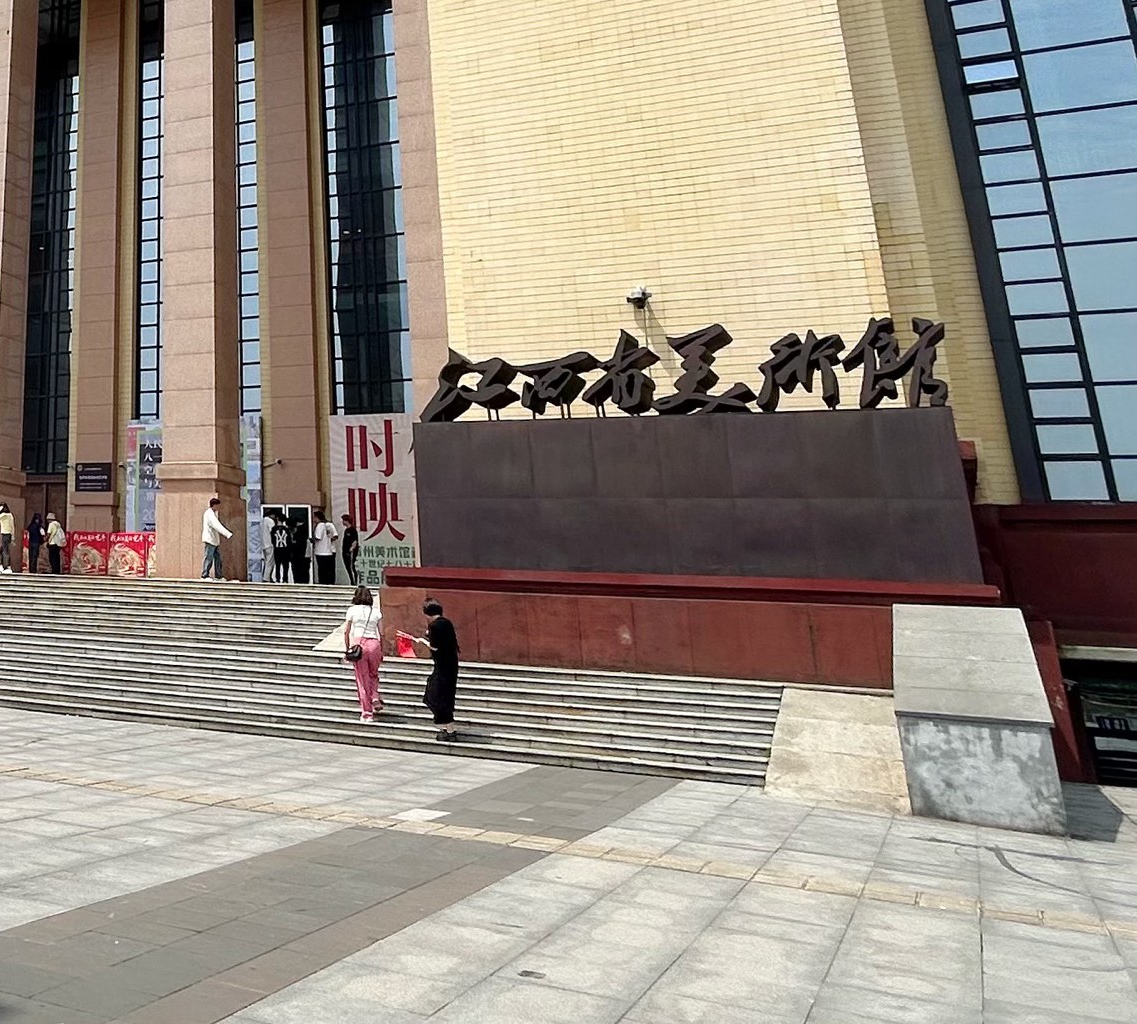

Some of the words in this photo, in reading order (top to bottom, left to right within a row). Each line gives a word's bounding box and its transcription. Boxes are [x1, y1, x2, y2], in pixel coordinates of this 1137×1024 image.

[356, 559, 415, 568] 十世纪七八十
